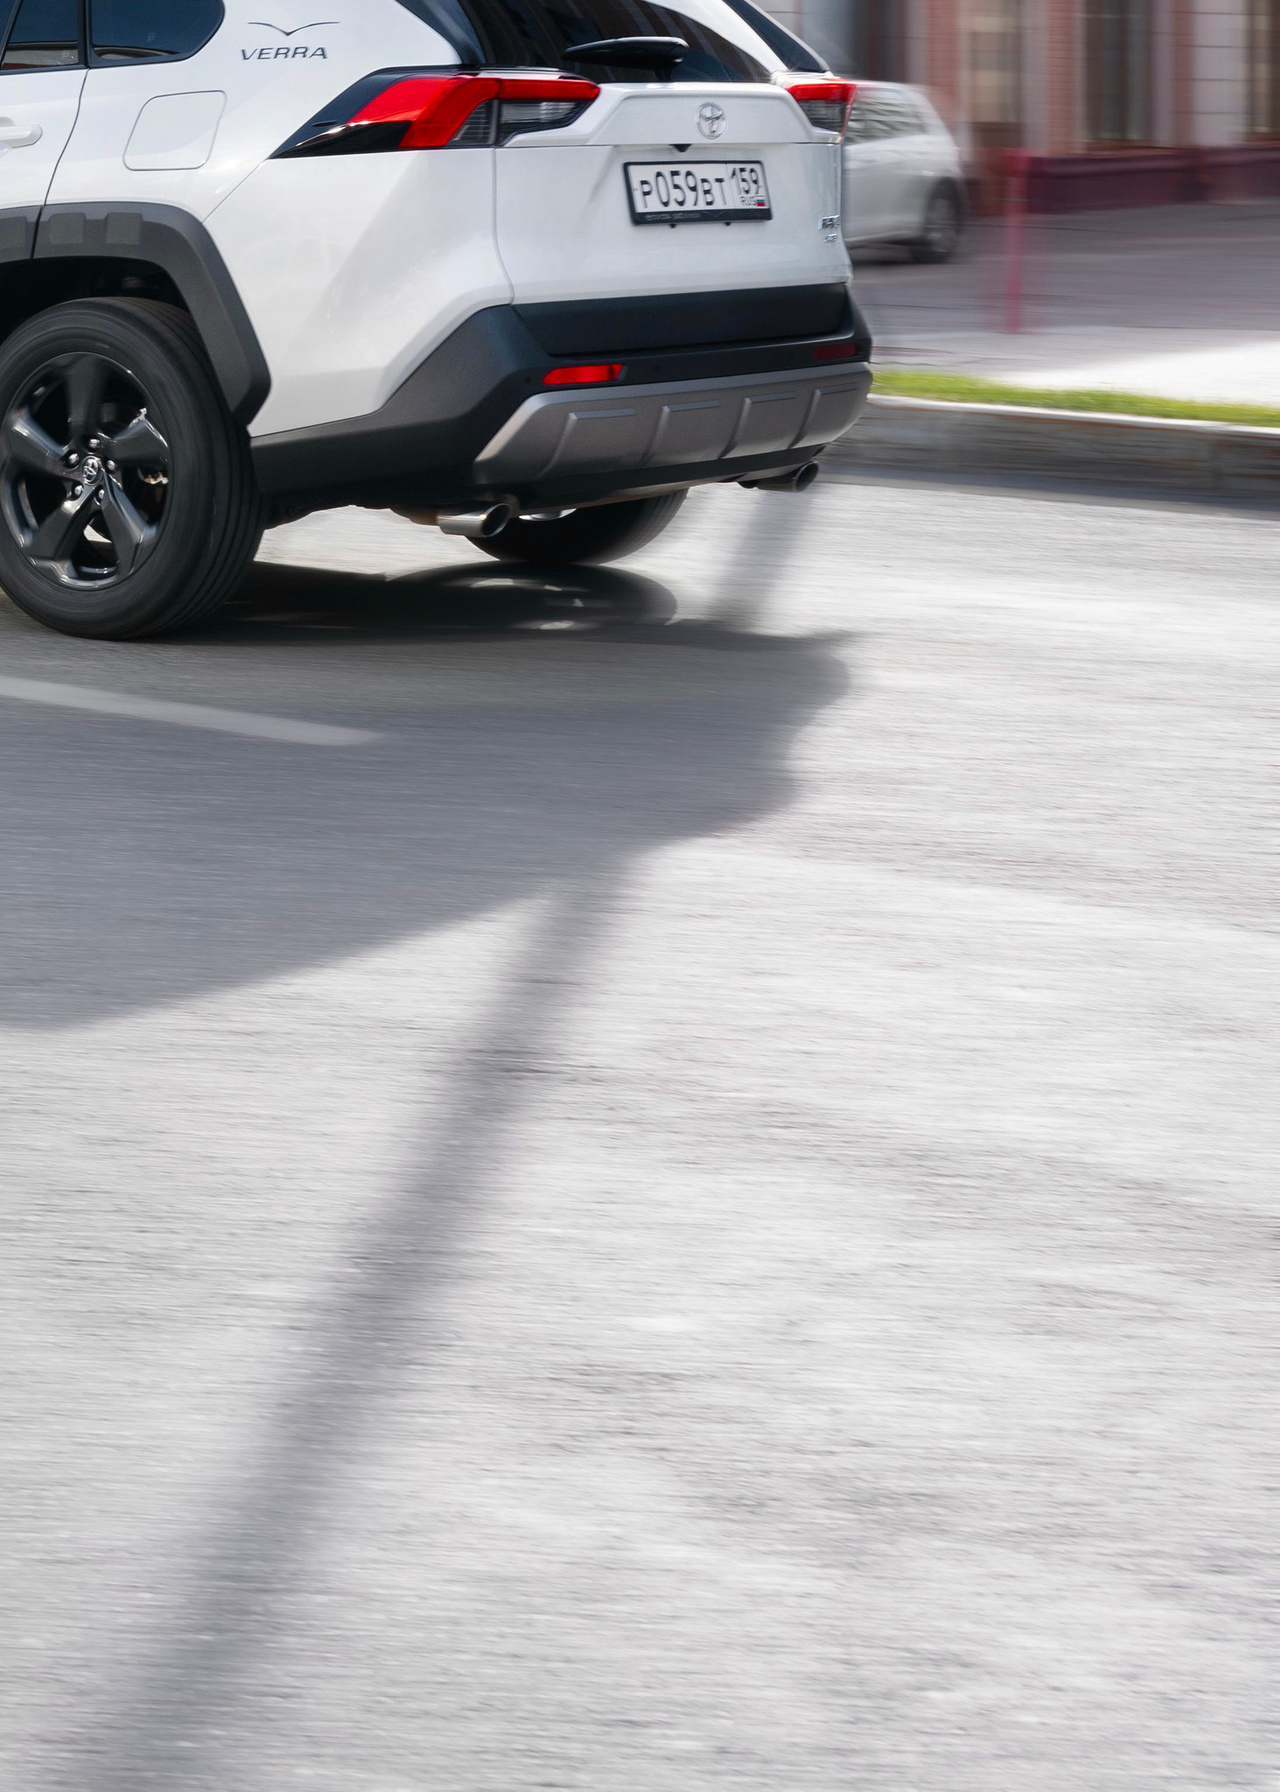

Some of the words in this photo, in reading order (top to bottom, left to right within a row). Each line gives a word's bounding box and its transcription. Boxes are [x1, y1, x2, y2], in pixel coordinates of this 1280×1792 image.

[240, 46, 328, 61] VERRA
[730, 167, 760, 195] 159
[739, 195, 757, 206] RUS
